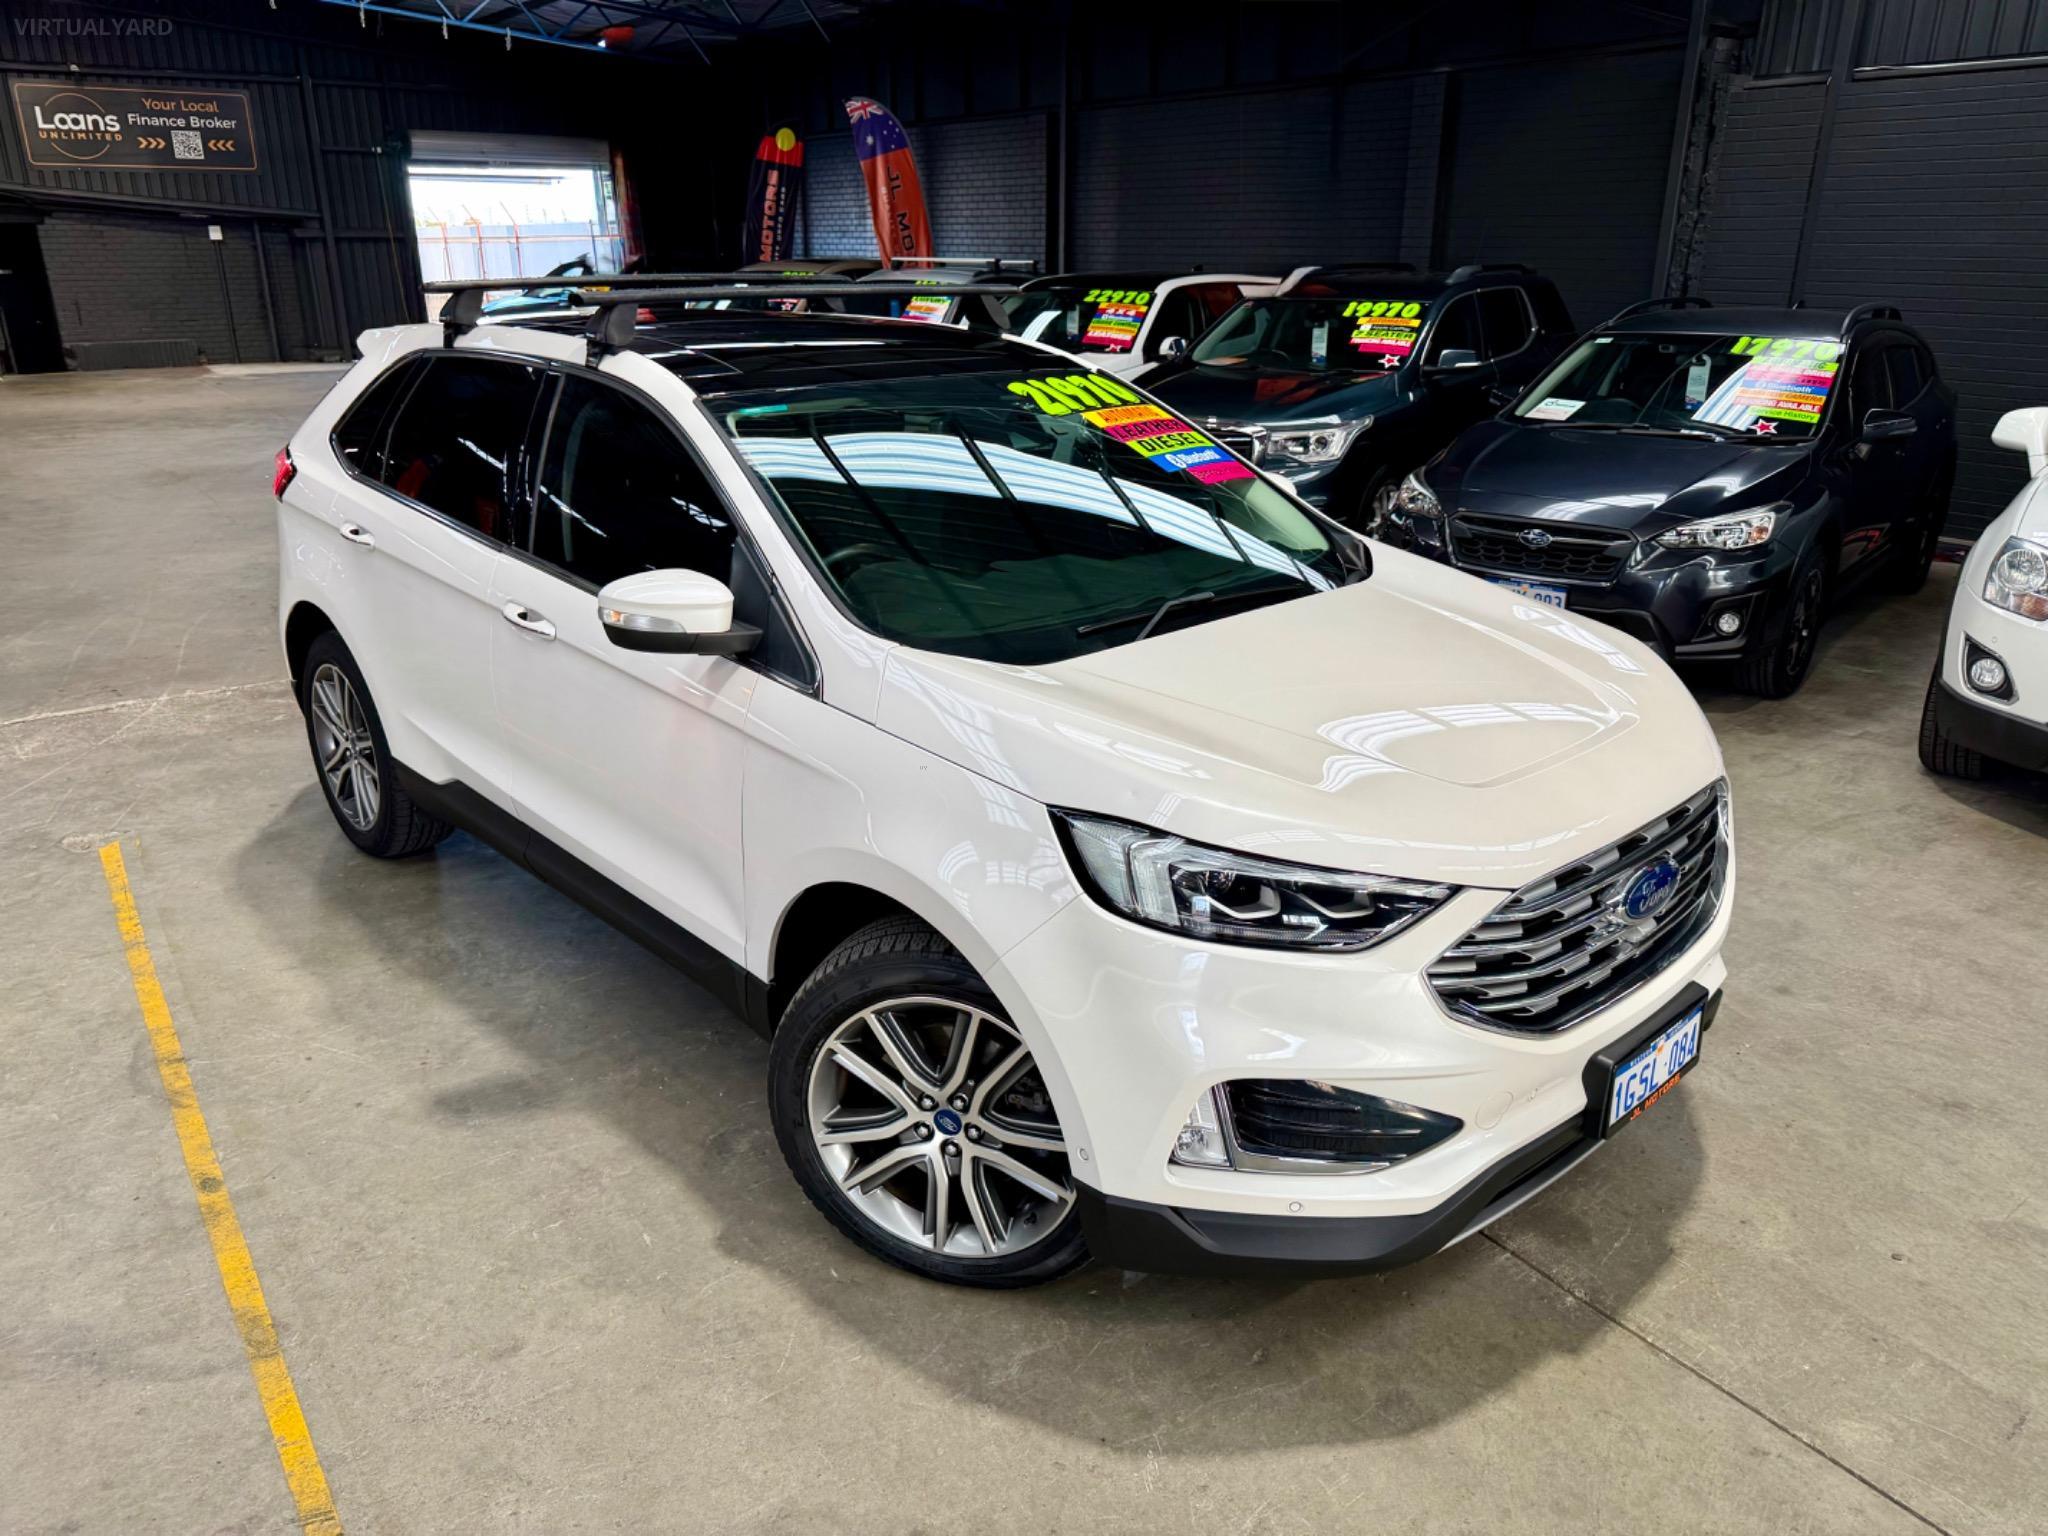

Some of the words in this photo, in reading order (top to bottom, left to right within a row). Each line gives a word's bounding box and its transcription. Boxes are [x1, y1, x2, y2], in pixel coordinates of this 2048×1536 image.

[142, 98, 176, 112] Your
[182, 100, 219, 113] Local
[34, 106, 121, 131] Loans
[127, 113, 186, 128] Finance
[190, 116, 237, 129] Broker
[39, 131, 123, 142] UNLIMITED
[887, 166, 901, 200] JL
[1083, 290, 1150, 305] 22970
[1342, 301, 1420, 318] 19970
[1730, 336, 1838, 360] 17970
[1007, 374, 1141, 416] 21970
[1784, 410, 1815, 421] History
[1114, 419, 1183, 441] LEATHER
[1137, 432, 1203, 452] DIESEL
[1668, 1022, 1697, 1076] 084
[1615, 1058, 1659, 1119] 1GSL
[1645, 1073, 1680, 1111] MOTORS
